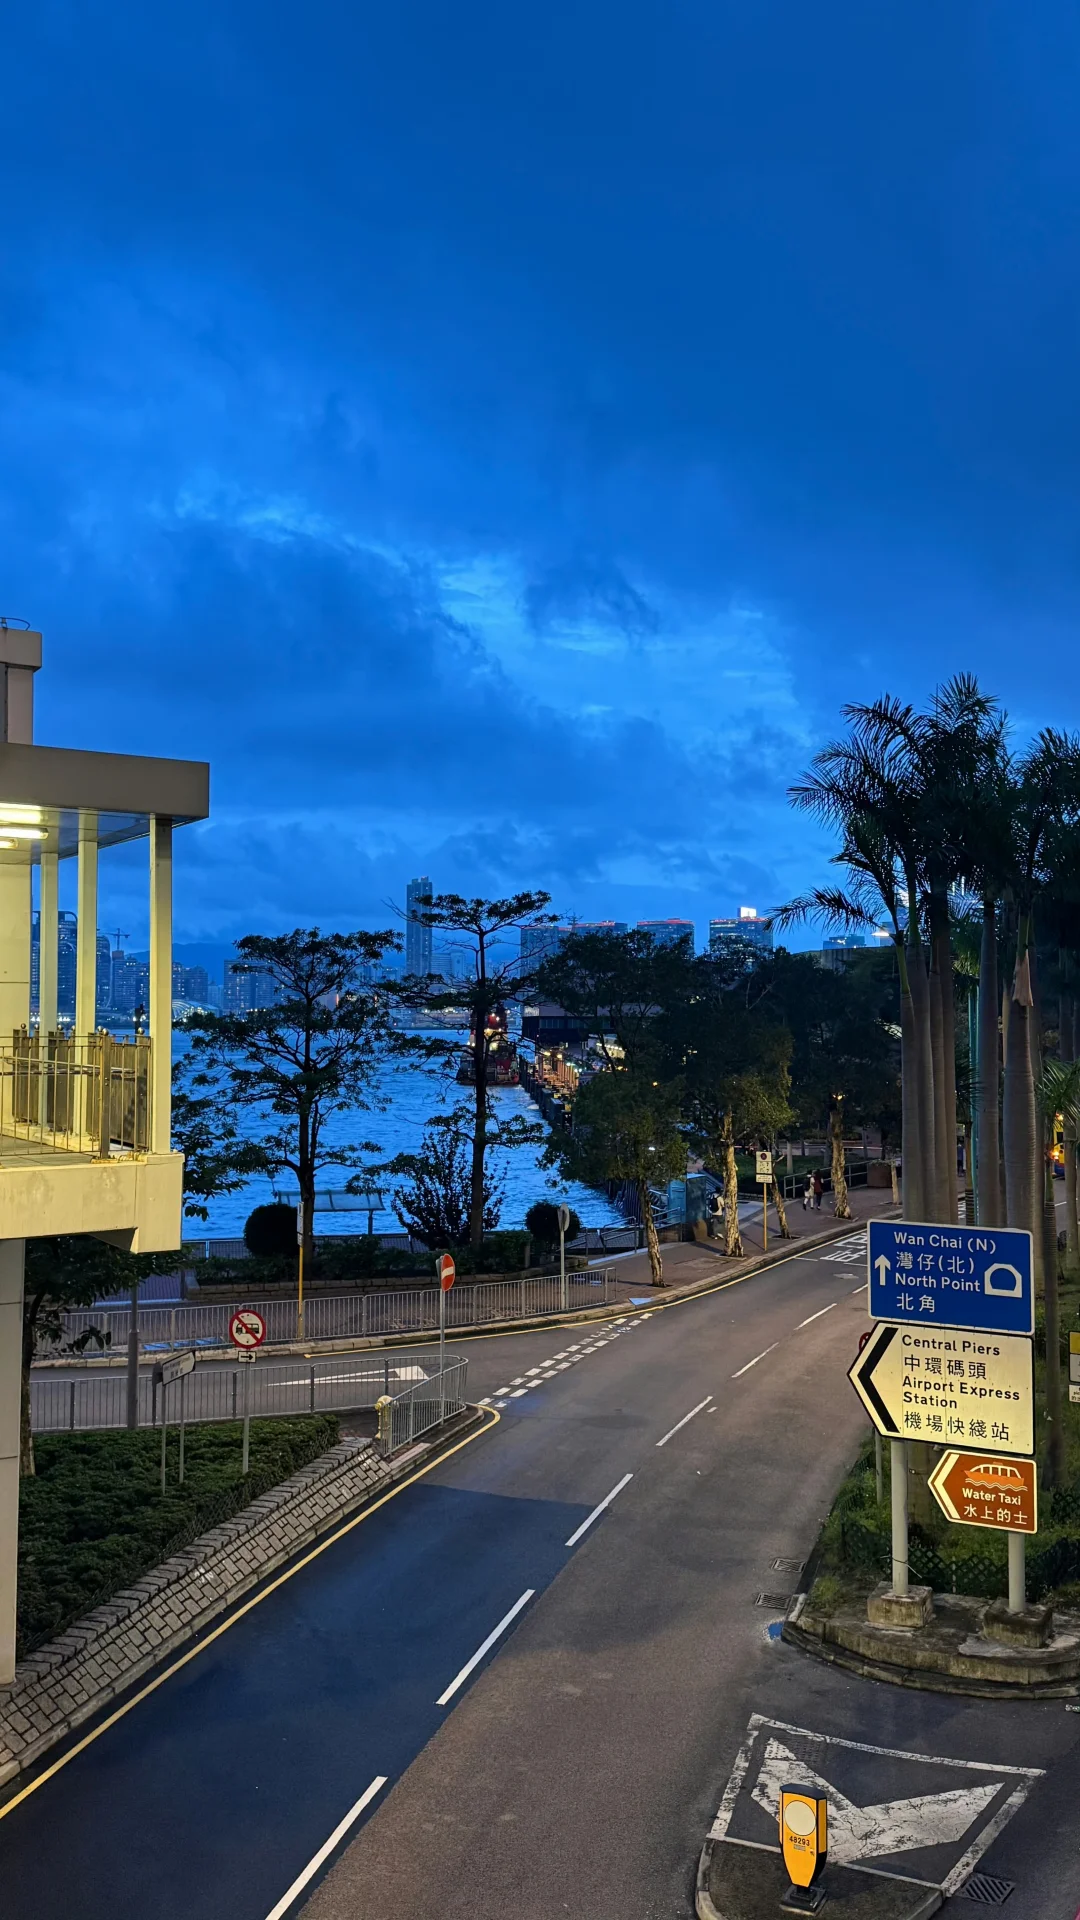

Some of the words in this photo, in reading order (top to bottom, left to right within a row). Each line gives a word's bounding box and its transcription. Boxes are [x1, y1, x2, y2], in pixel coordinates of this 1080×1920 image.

[893, 1231, 925, 1246] Wan
[929, 1234, 962, 1249] Chai
[967, 1237, 997, 1253] (N)
[896, 1251, 975, 1274] 灣仔(北)
[895, 1272, 937, 1288] North
[941, 1276, 981, 1292] Point
[896, 1292, 935, 1313] 北角
[902, 1334, 957, 1351] Central
[962, 1340, 1000, 1356] Piers
[904, 1354, 987, 1380] 中環碼頭
[902, 1375, 955, 1393] Airport
[959, 1382, 1020, 1401] Express
[903, 1391, 958, 1409] Station
[904, 1410, 1009, 1441] 機場快綫站
[962, 1487, 996, 1502] Water
[998, 1492, 1021, 1506] Taxi
[963, 1503, 1028, 1525] 水上的士
[789, 1836, 810, 1846] 48293
